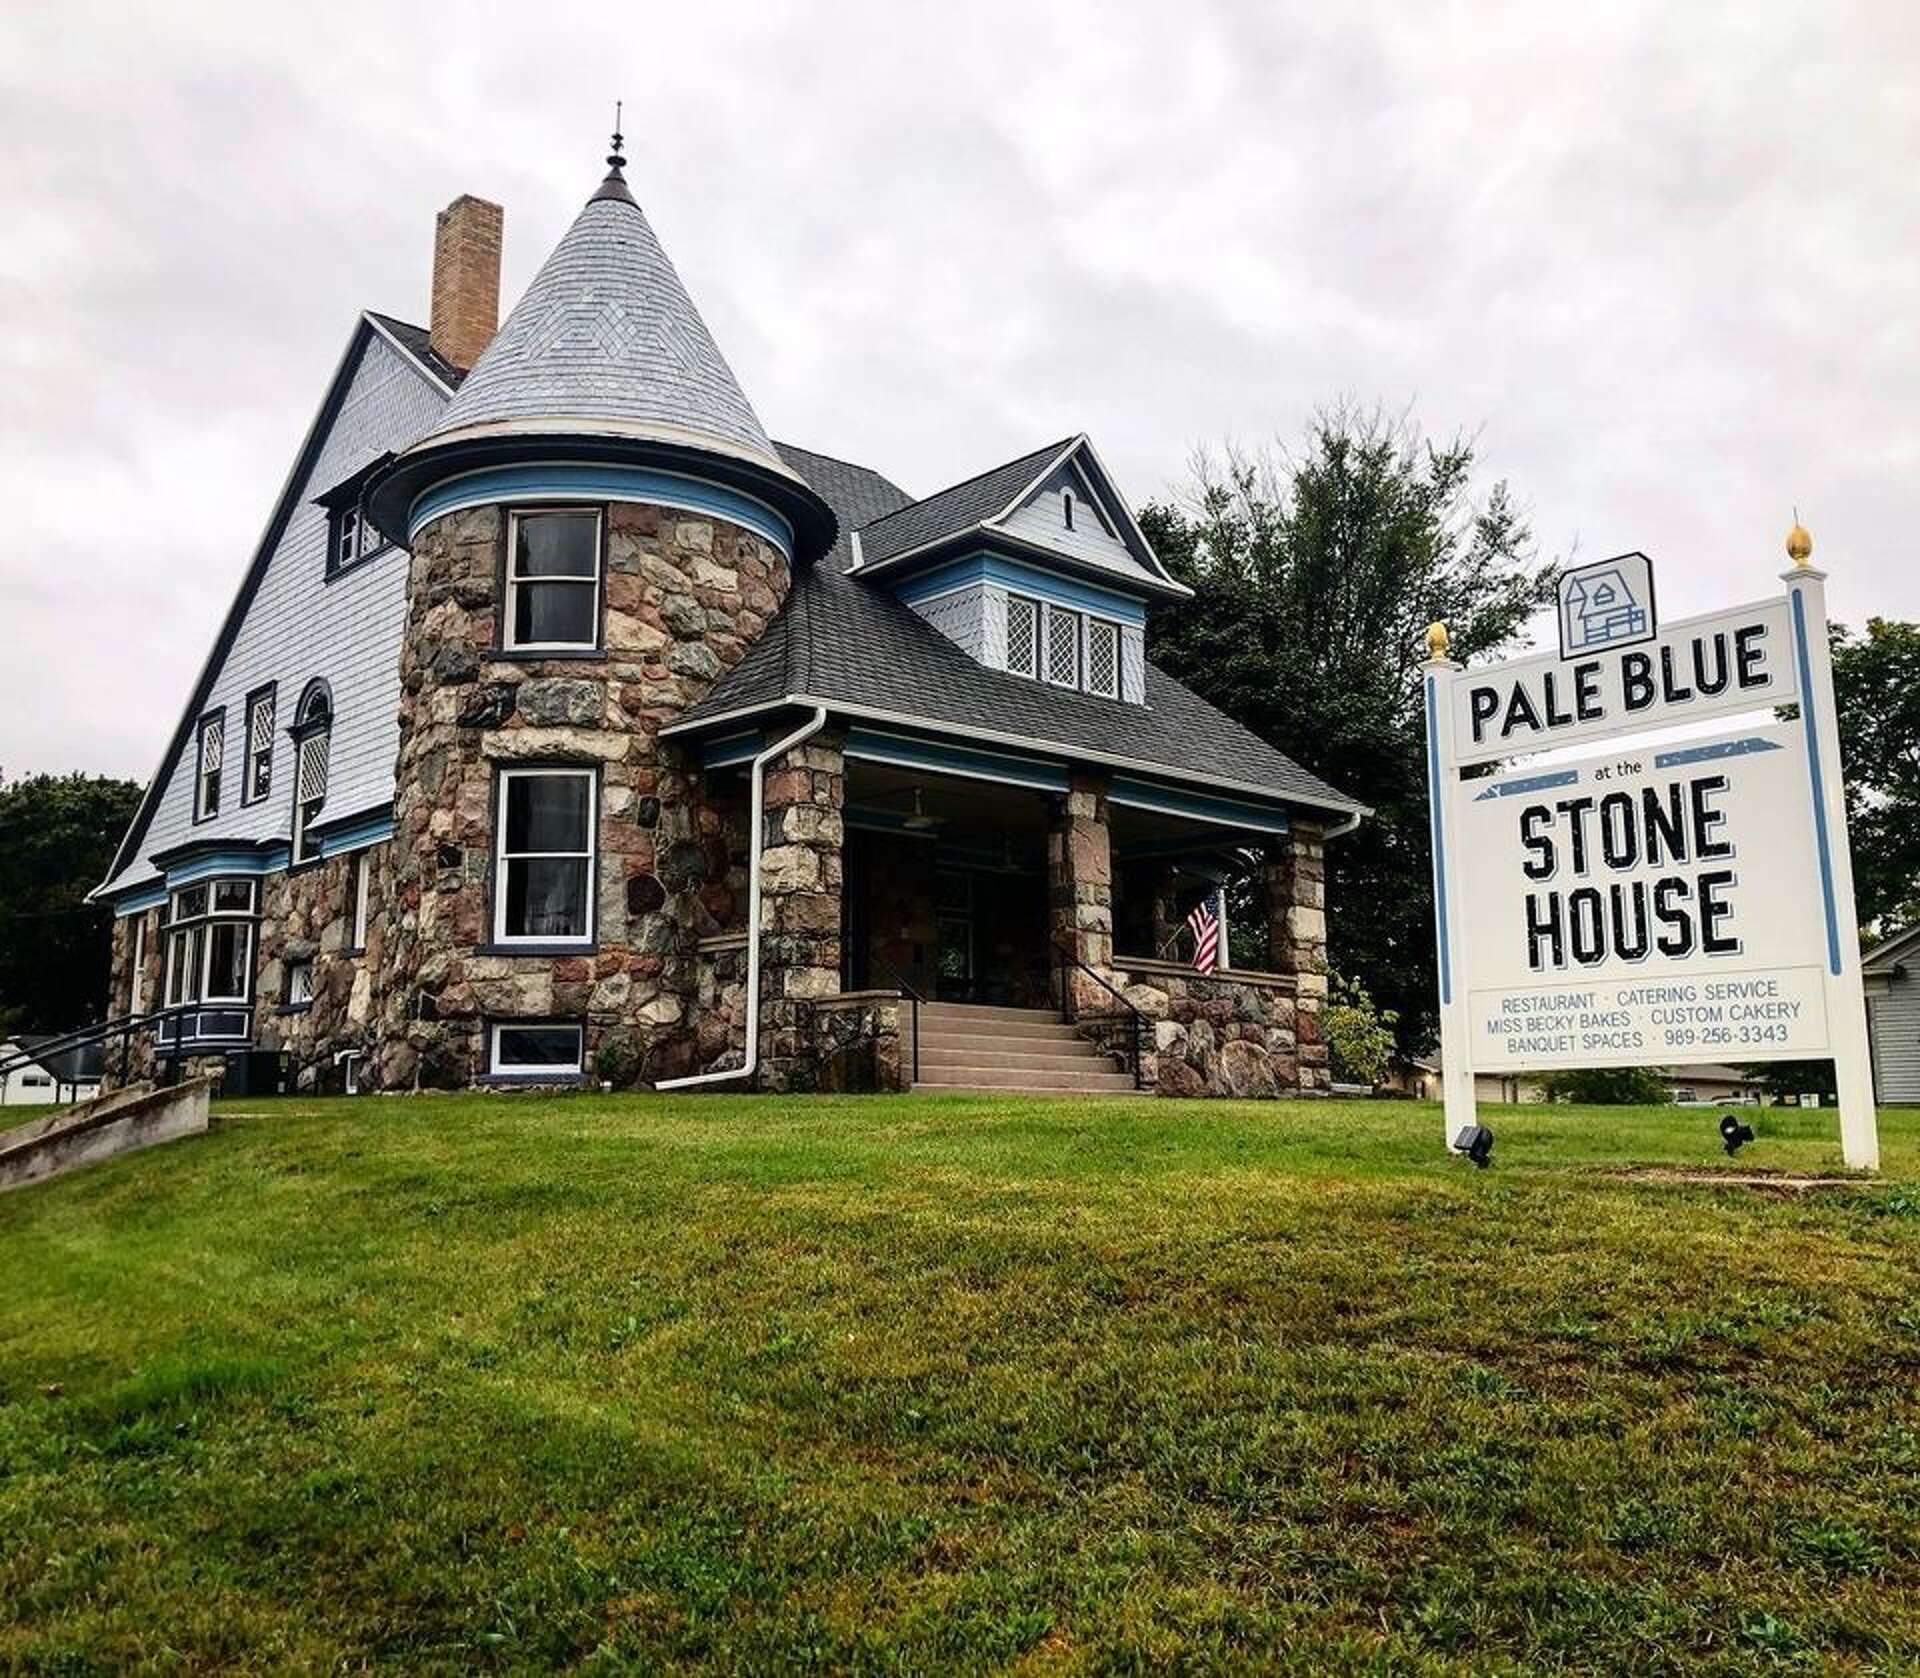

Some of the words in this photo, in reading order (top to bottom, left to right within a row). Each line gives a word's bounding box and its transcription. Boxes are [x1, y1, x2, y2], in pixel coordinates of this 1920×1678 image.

[1470, 662, 1606, 744] PALE
[1620, 623, 1772, 713] BLUE
[1595, 766, 1612, 781] at
[1616, 761, 1642, 777] the
[1519, 775, 1736, 882] STONE
[1525, 869, 1742, 974] HOUSE
[1502, 992, 1595, 1014] RESTAURANT
[1617, 985, 1697, 1007] CATERING
[1704, 980, 1778, 1000] SERVICE
[1487, 1018, 1522, 1034] MISS
[1527, 1015, 1574, 1032] BECKY
[1580, 1011, 1631, 1029] BAKES
[1651, 1006, 1723, 1025] CUSTOM
[1729, 1001, 1801, 1022] CAKERY
[1507, 1034, 1576, 1054] BANQUET
[1583, 1031, 1643, 1050] SPACES
